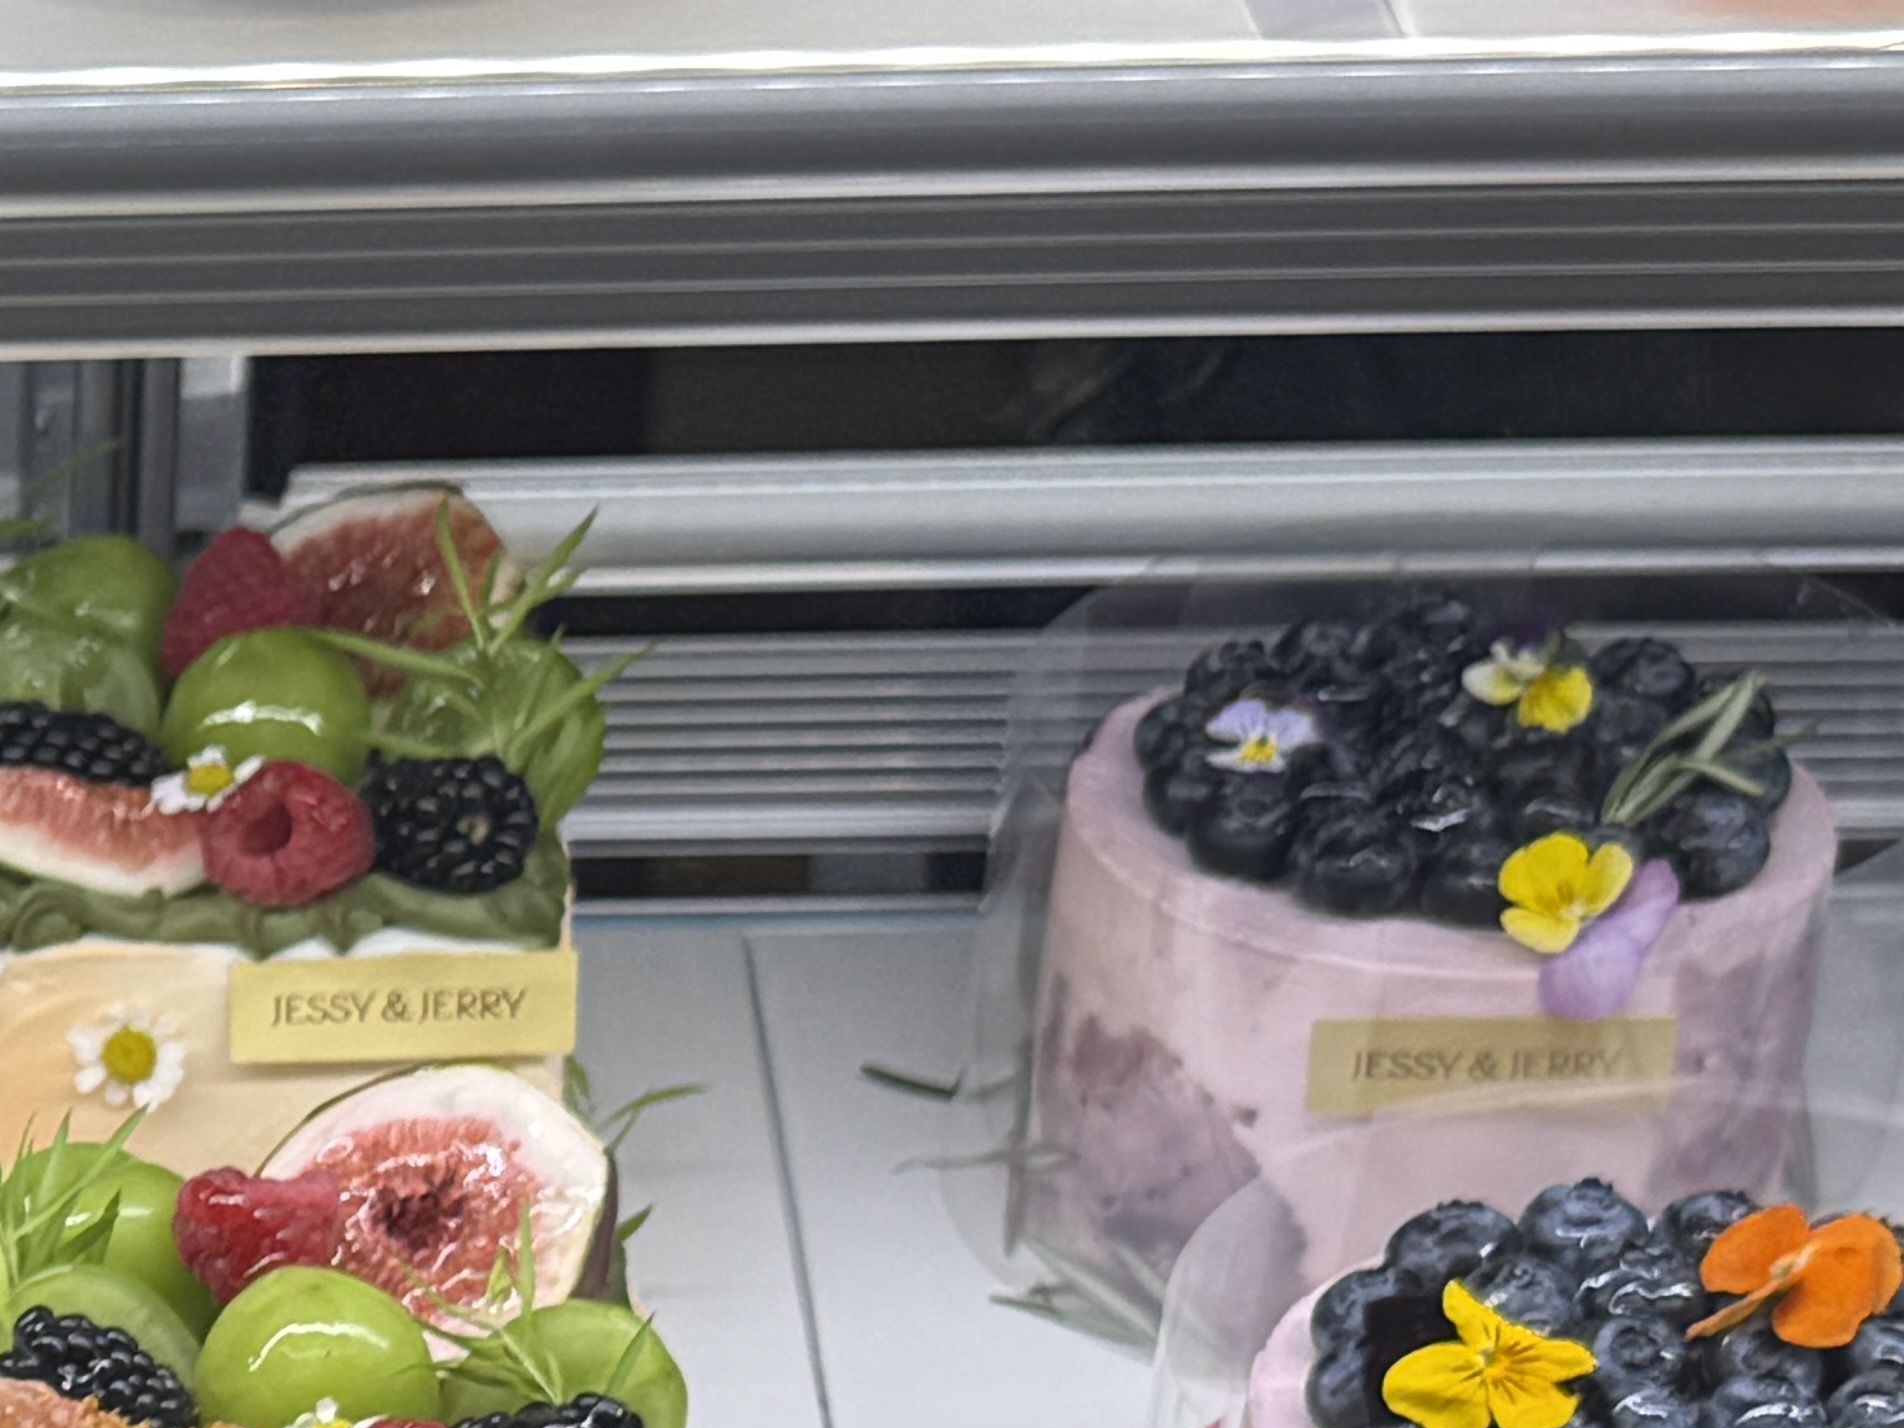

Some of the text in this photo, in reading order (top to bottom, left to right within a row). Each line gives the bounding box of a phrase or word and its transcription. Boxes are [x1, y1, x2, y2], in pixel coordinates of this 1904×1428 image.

[272, 987, 527, 1028] JESSY & JERRY
[1352, 1049, 1622, 1083] JESSY & JERRY
